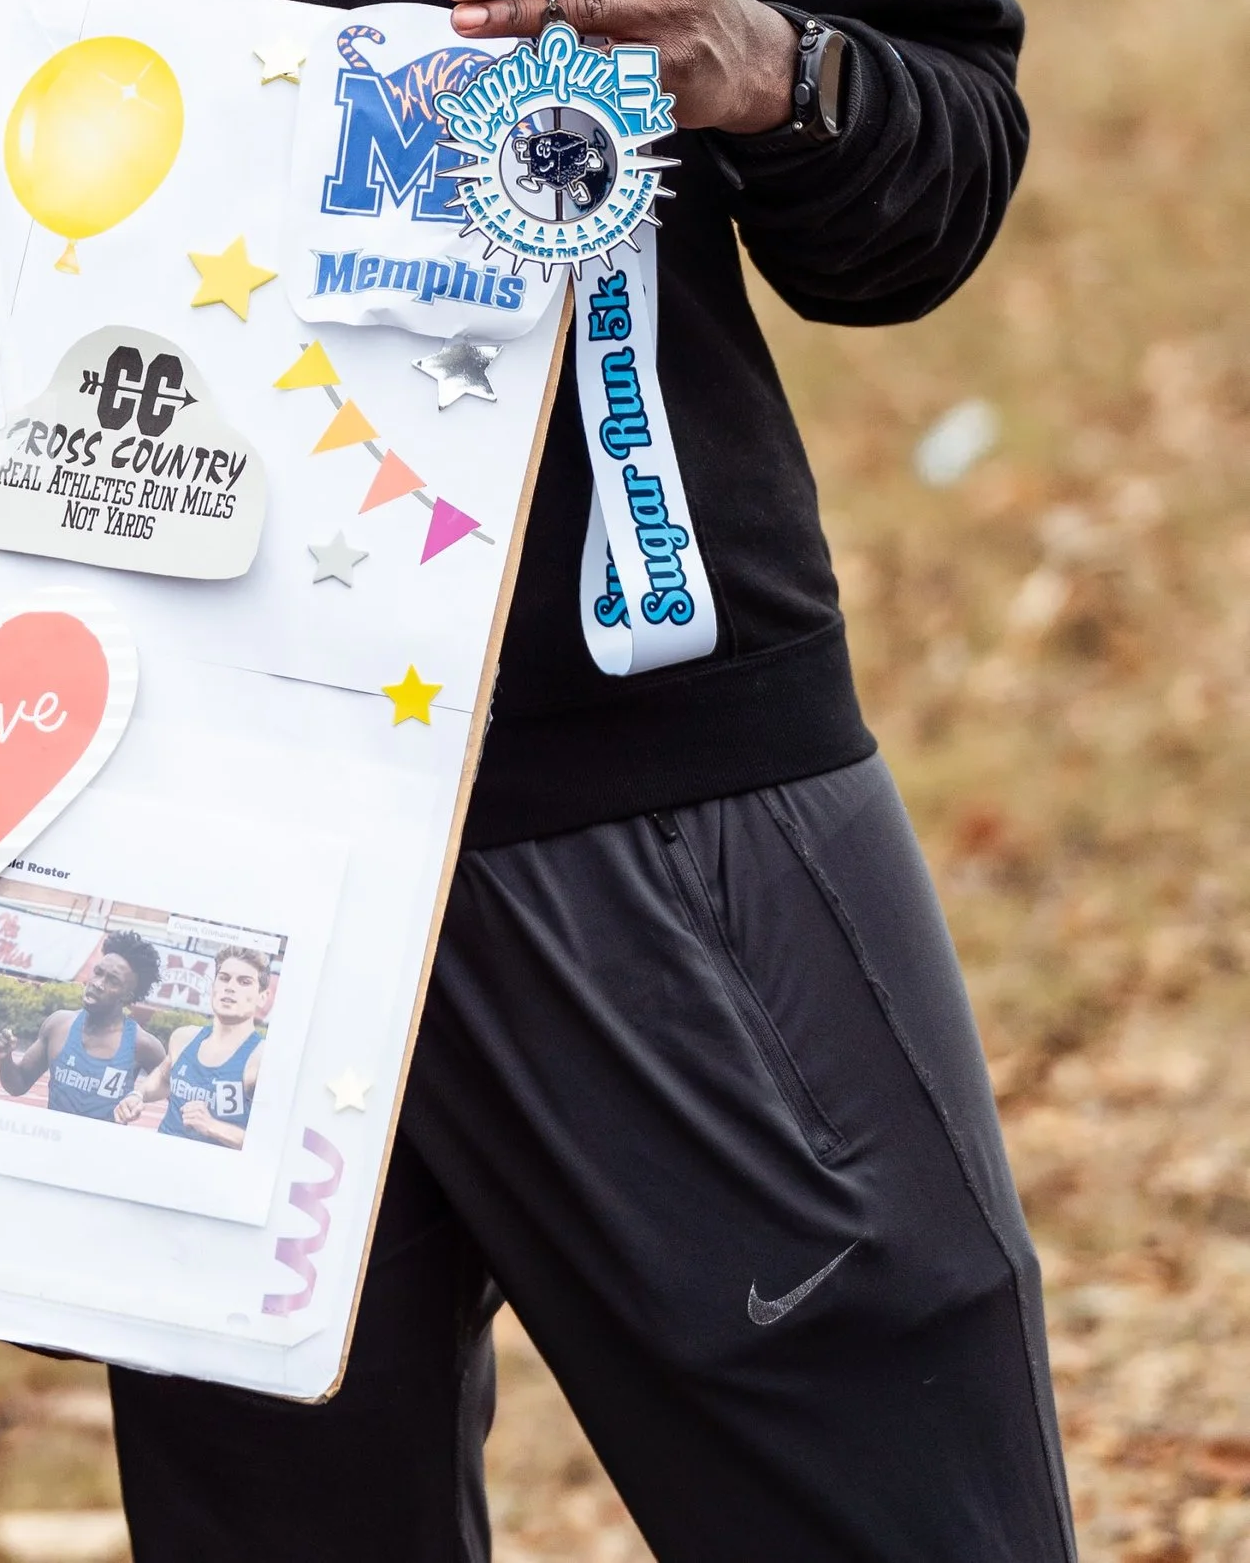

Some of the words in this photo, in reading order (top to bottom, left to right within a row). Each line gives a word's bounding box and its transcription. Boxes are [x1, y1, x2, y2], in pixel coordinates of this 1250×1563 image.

[434, 46, 544, 153] Sugar
[539, 25, 616, 102] Run
[307, 248, 527, 311] Memphis
[97, 345, 184, 437] CC
[598, 345, 653, 461] Run
[111, 436, 247, 491] COUNTRY
[46, 464, 136, 507] ATHLETES
[139, 478, 180, 513] RUN
[179, 484, 237, 519] MILES
[60, 499, 100, 532] NOT
[103, 505, 156, 540] YARDS
[622, 463, 695, 627] Sugar
[27, 862, 71, 880] Roster
[54, 1065, 101, 1093] MEMP
[103, 1072, 122, 1096] 4
[170, 1076, 217, 1111] MEMPH
[222, 1084, 238, 1114] 3
